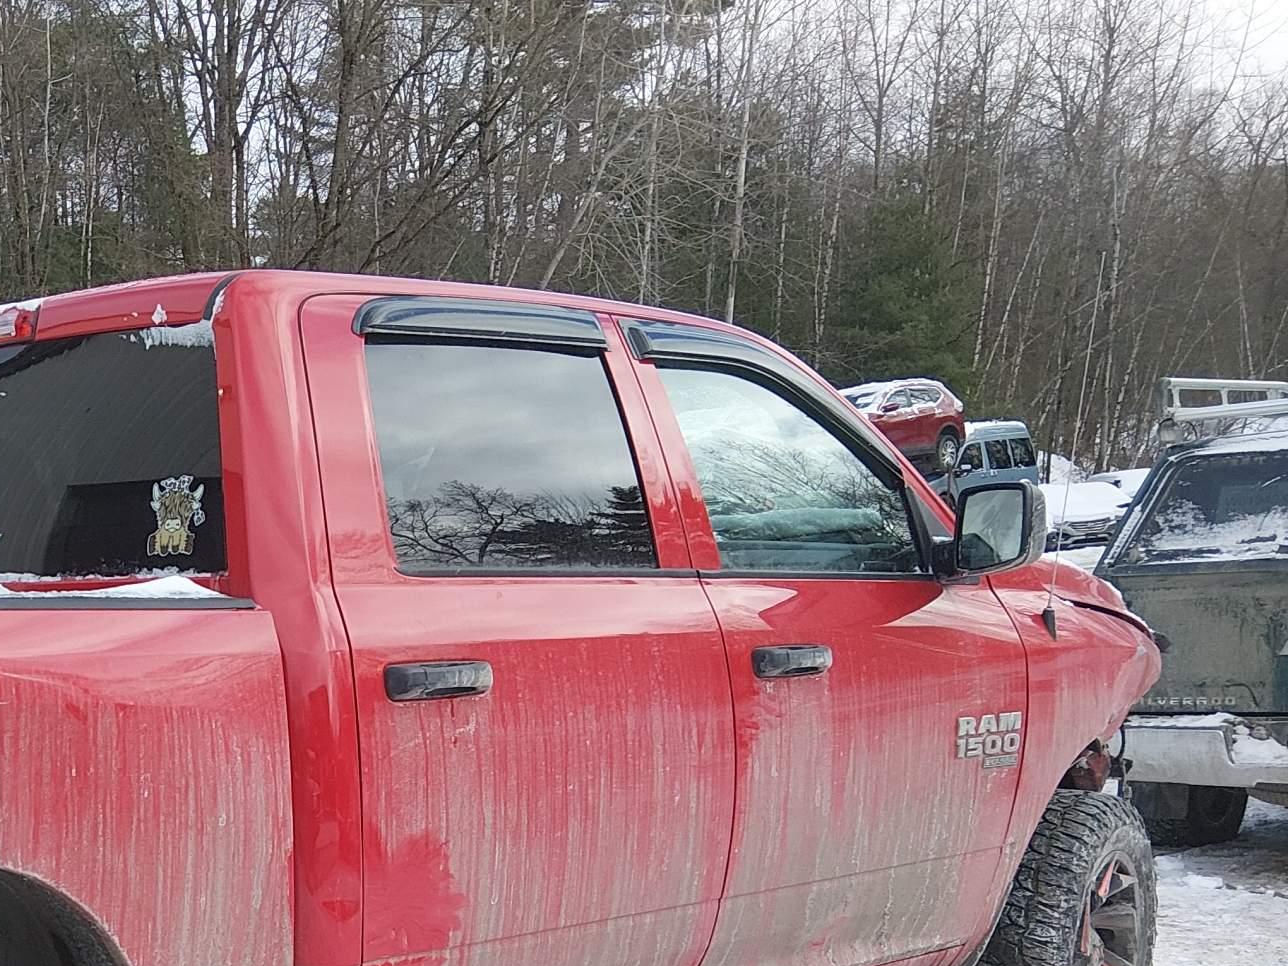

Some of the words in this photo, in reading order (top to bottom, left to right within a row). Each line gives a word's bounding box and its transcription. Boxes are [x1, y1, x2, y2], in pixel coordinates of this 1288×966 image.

[1137, 696, 1237, 705] ILVERADO
[957, 711, 1022, 736] RAM
[956, 732, 1021, 759] 1500
